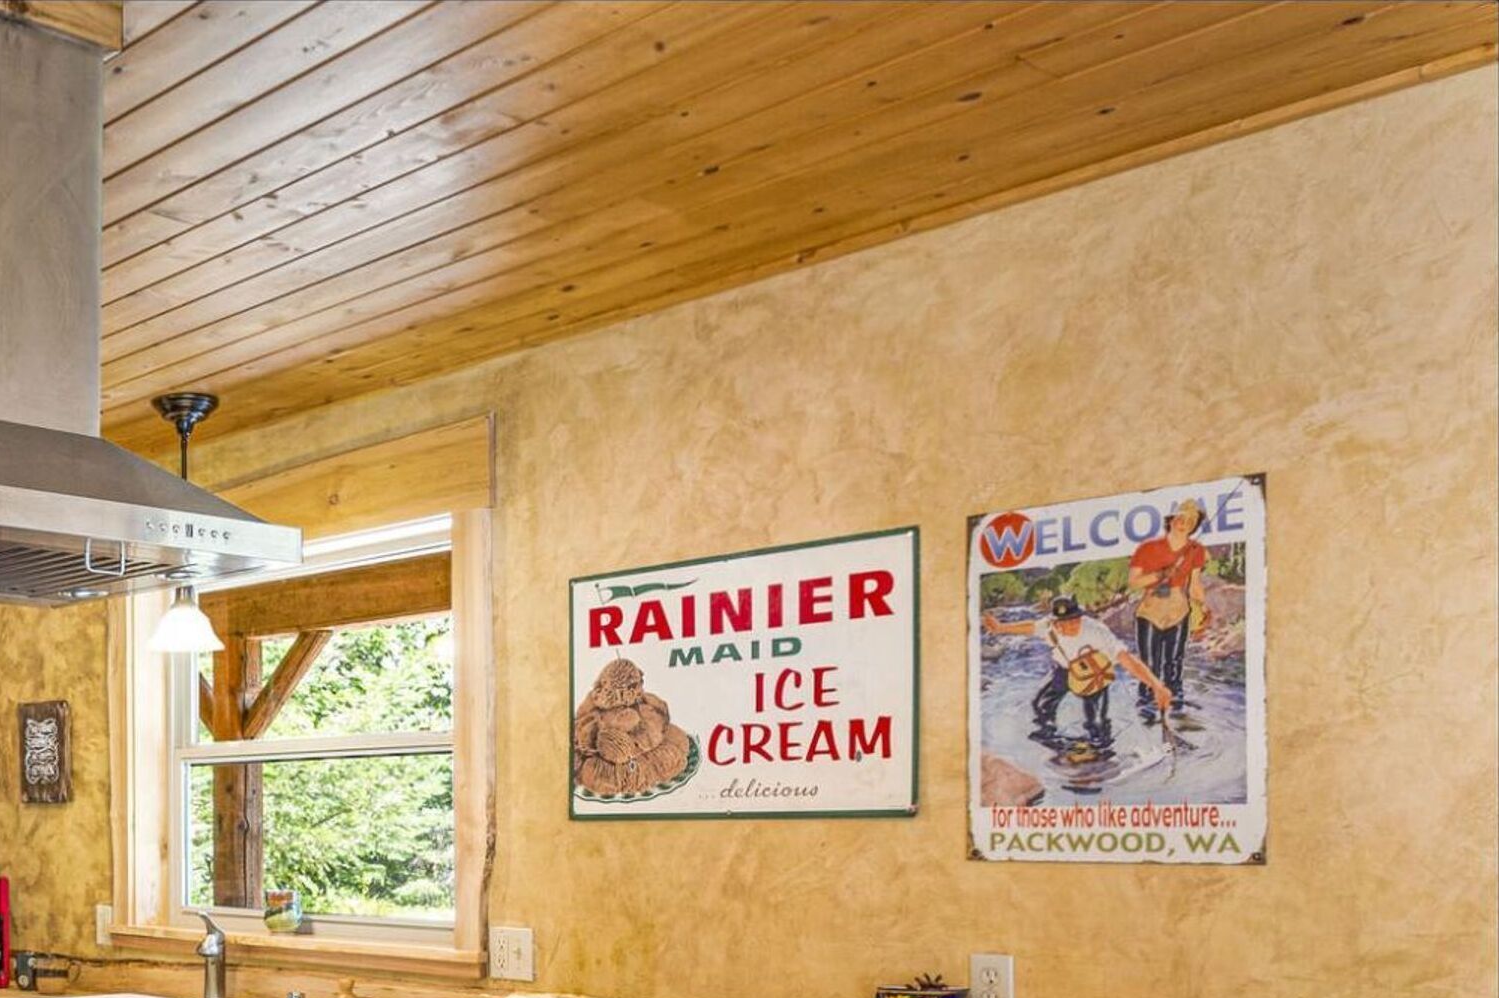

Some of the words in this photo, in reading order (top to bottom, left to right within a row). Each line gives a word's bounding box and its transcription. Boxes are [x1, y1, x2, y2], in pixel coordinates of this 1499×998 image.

[589, 569, 894, 648] RAINIER
[668, 637, 802, 668] MAID
[754, 666, 840, 713] ICE
[707, 716, 892, 766] CREAM
[992, 803, 1012, 828] for
[1016, 802, 1057, 828] those
[1060, 801, 1095, 828] who
[1098, 800, 1128, 828] like
[989, 831, 1175, 857] PACKWOOD,
[1184, 831, 1242, 855] WA
